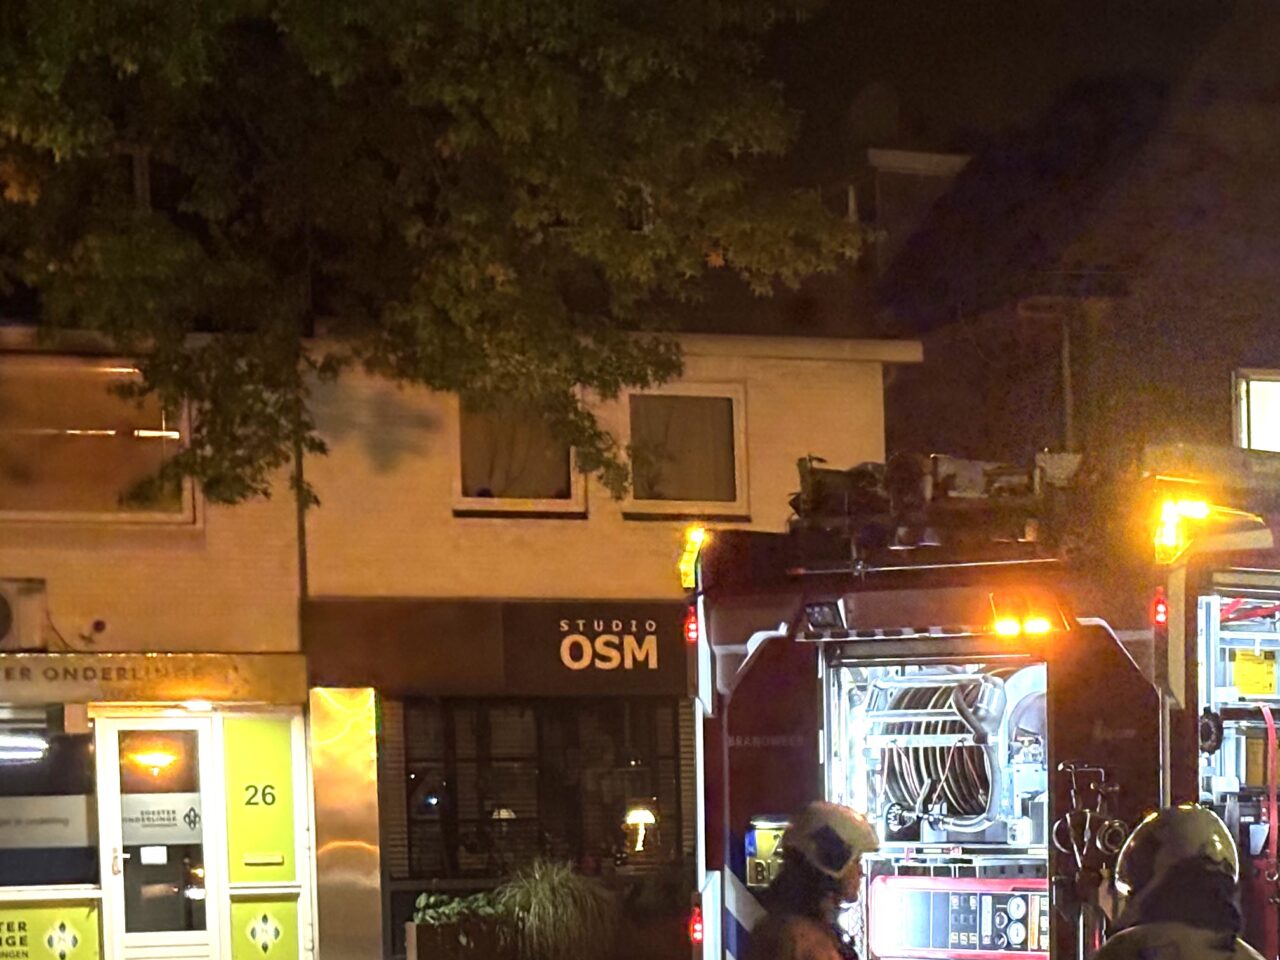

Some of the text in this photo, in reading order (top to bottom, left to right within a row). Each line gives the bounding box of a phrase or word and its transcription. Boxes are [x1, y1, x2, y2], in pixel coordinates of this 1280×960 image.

[559, 619, 657, 632] STUDIO
[560, 633, 658, 670] OSM
[244, 784, 276, 806] 26
